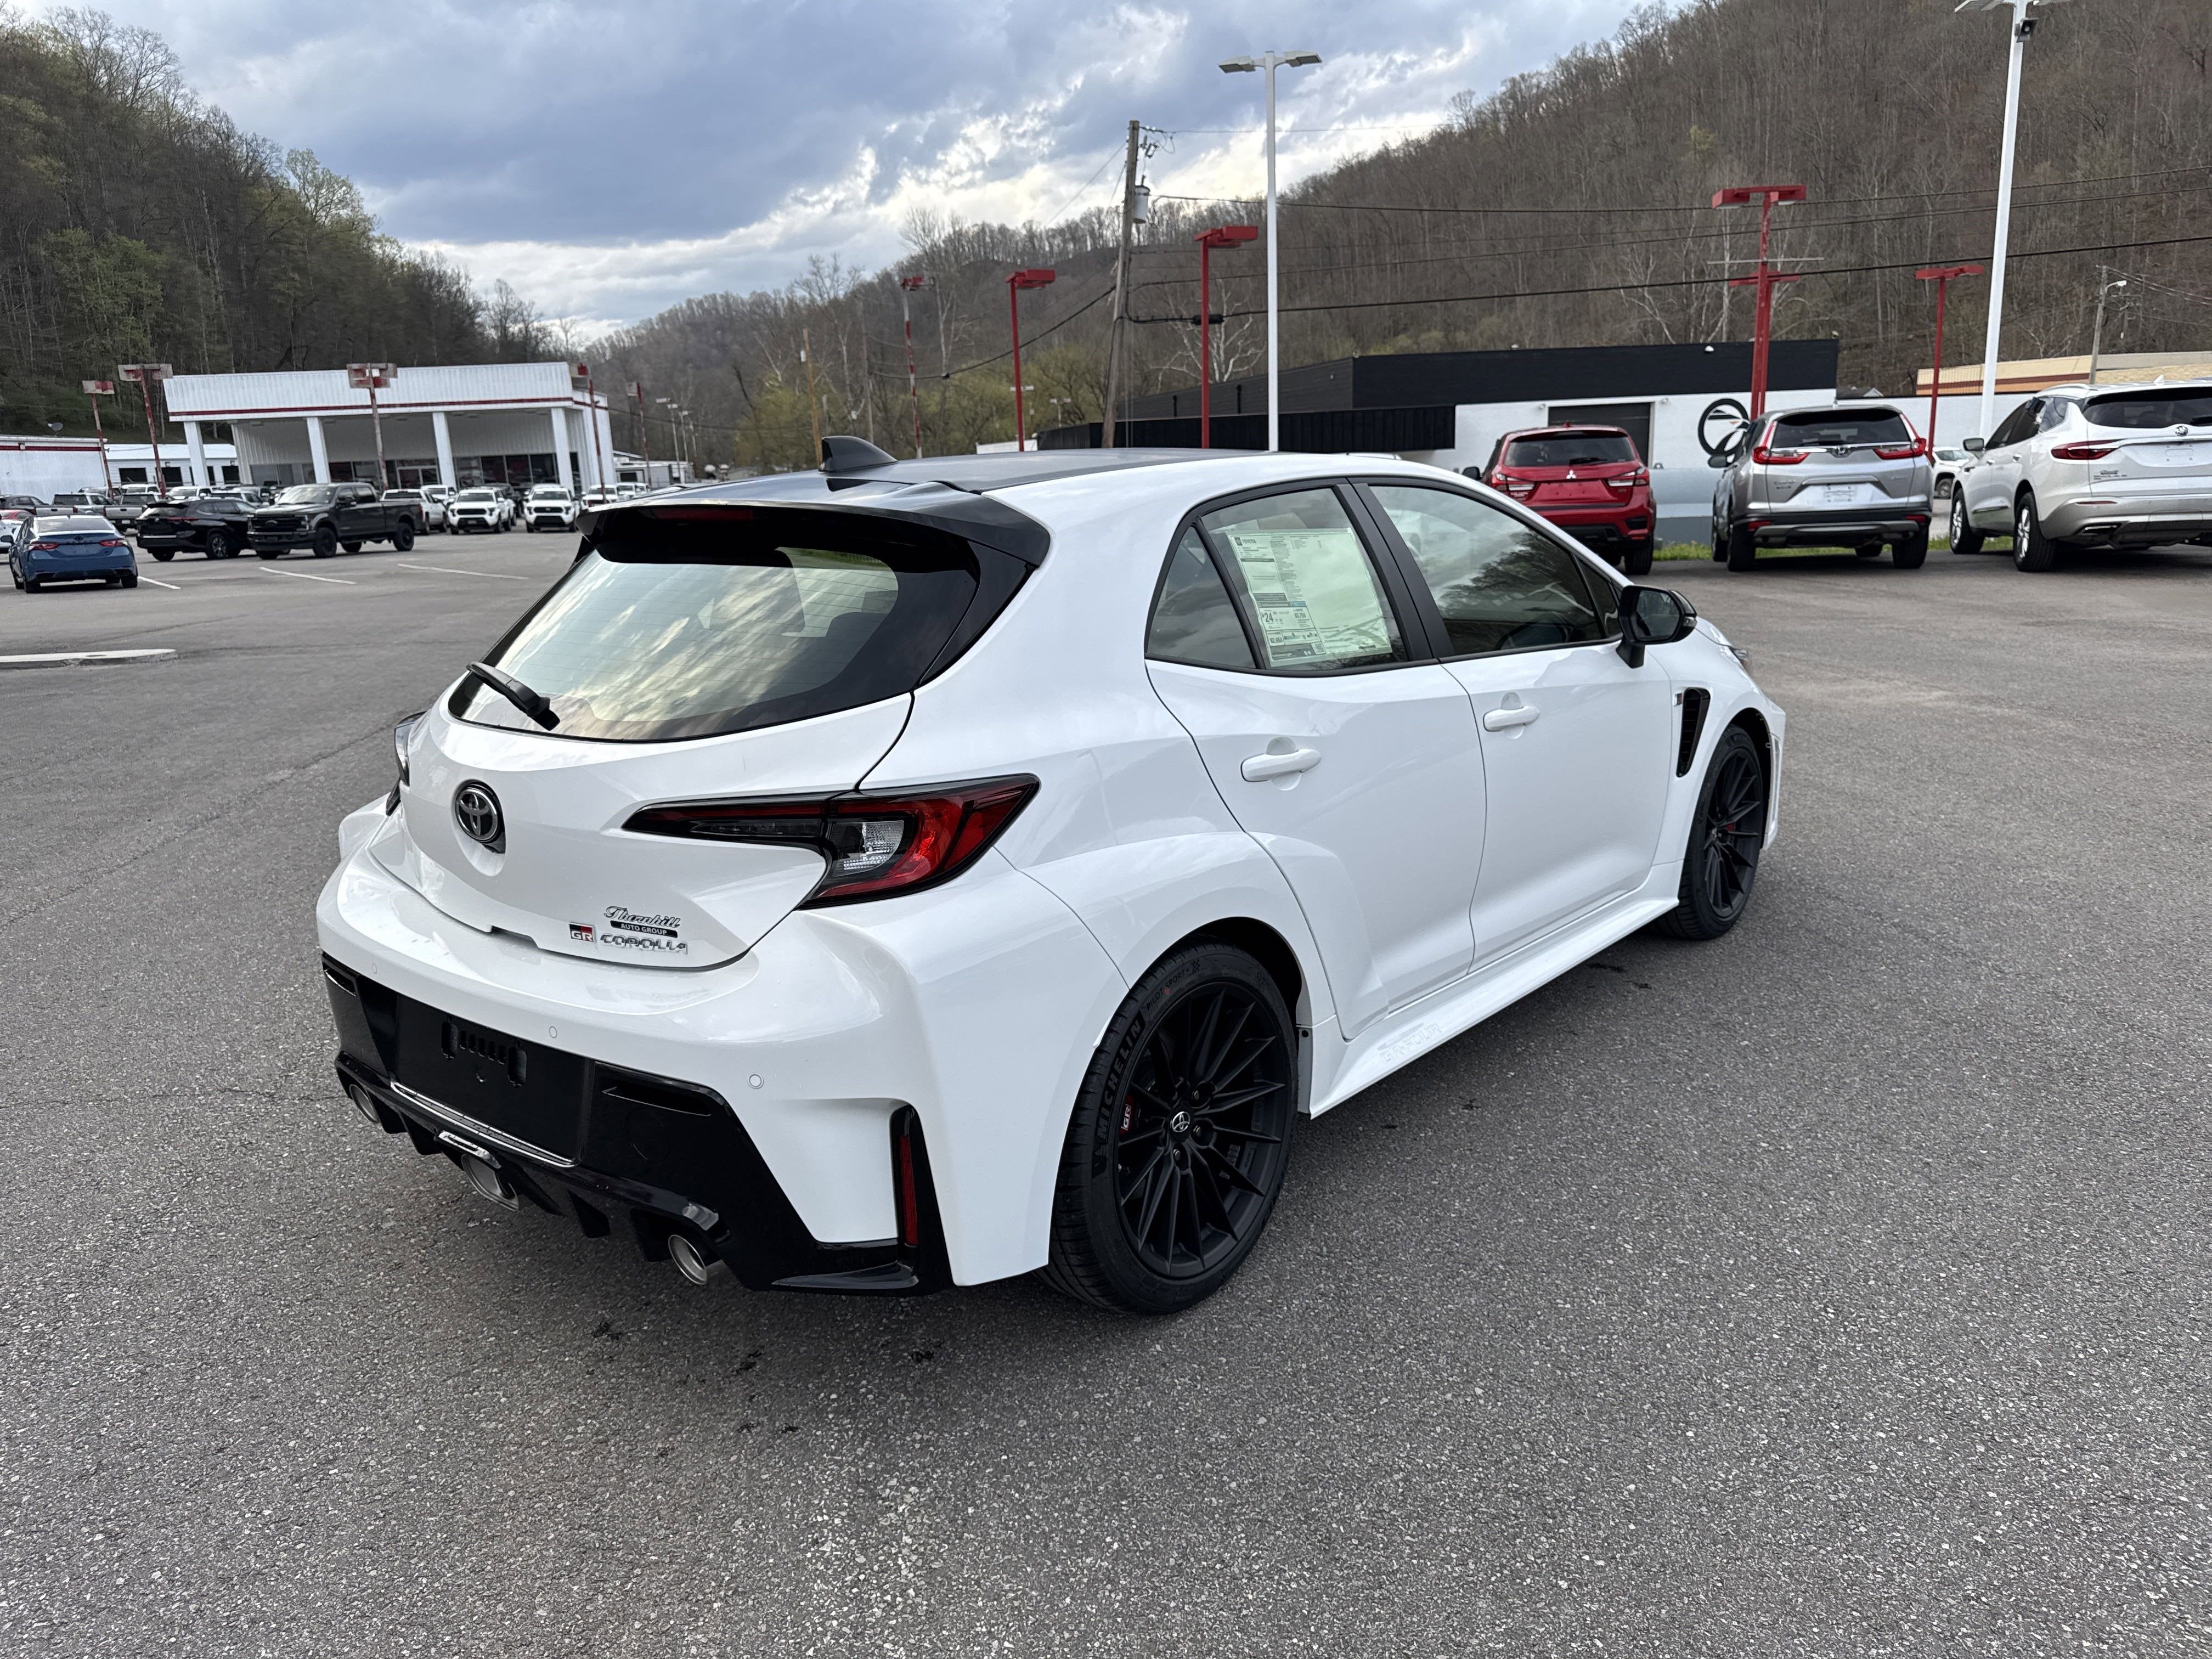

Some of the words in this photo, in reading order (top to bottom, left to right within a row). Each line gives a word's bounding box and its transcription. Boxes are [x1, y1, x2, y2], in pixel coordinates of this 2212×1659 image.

[1264, 612, 1273, 623] 24
[604, 906, 681, 928] Thornhill
[620, 923, 640, 932] AUTO
[641, 926, 667, 935] GROUP
[571, 930, 593, 943] GR
[600, 933, 688, 955] COROLLA
[1146, 988, 1164, 1011] PILOT
[1165, 969, 1186, 989] SPORT
[1097, 1019, 1142, 1139] MICHELIN
[1122, 1104, 1132, 1130] GR
